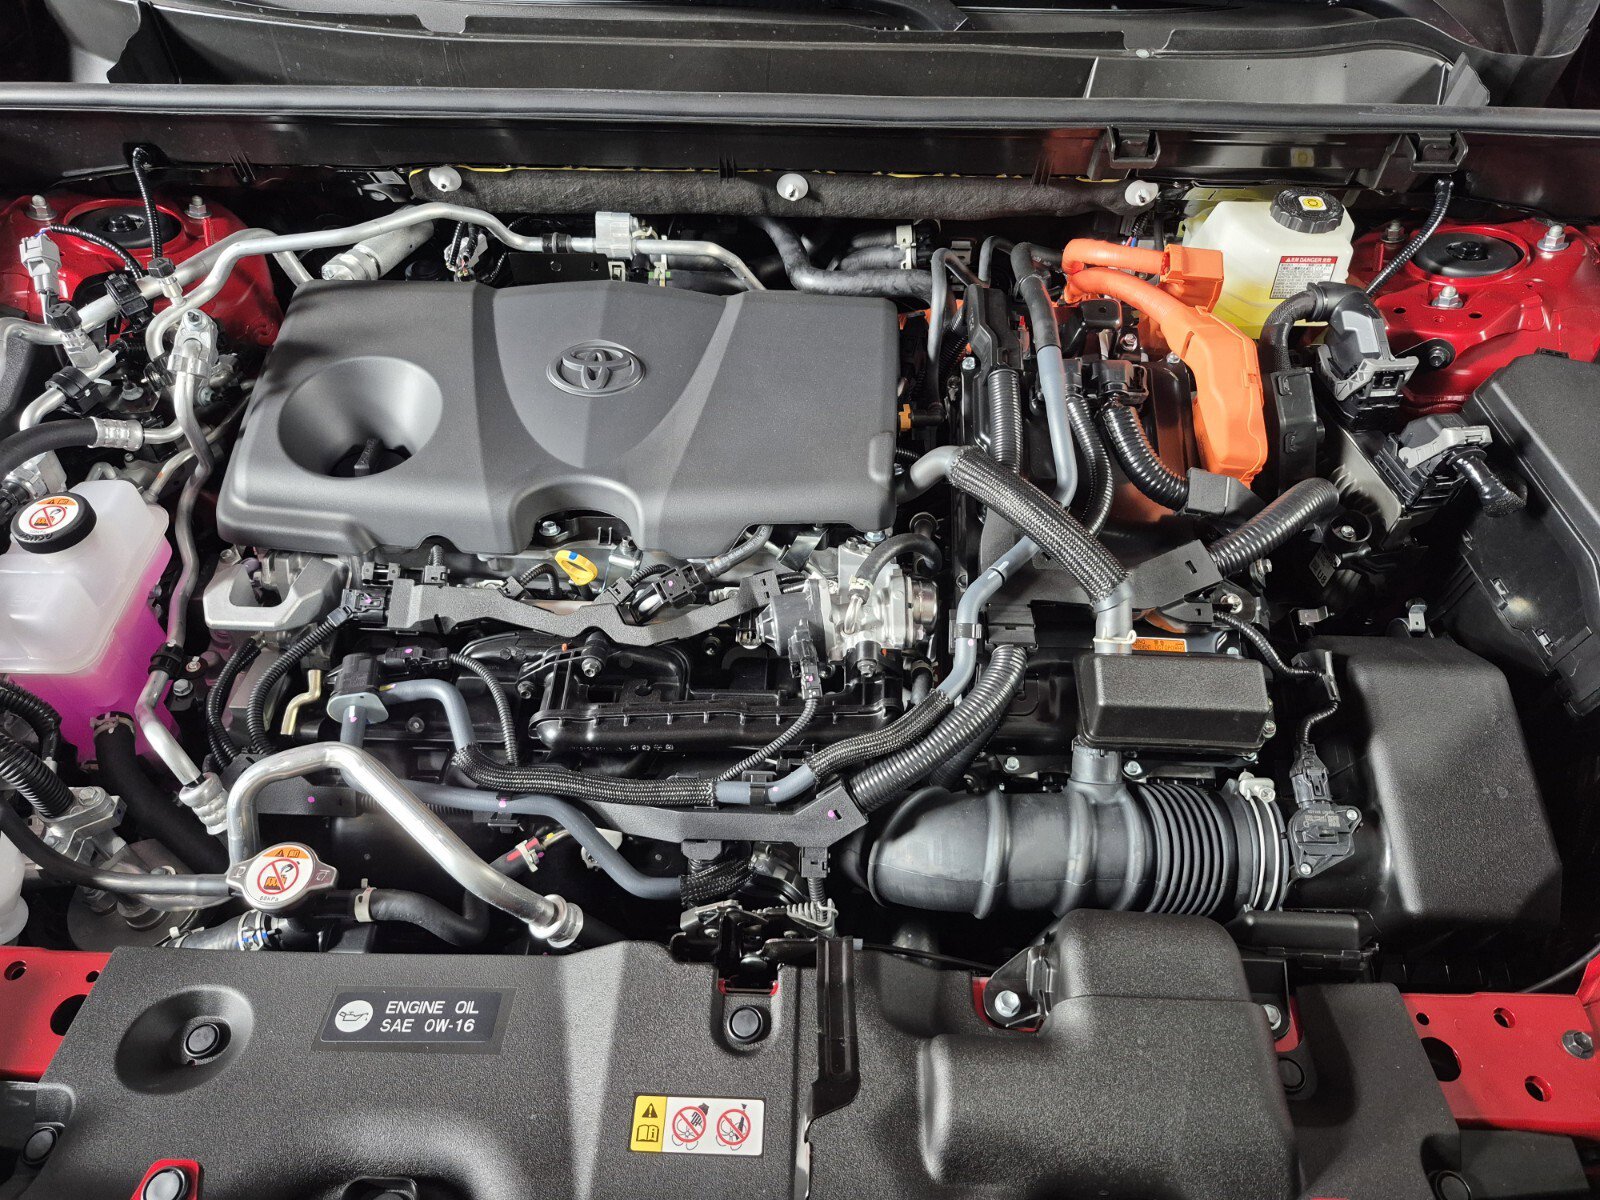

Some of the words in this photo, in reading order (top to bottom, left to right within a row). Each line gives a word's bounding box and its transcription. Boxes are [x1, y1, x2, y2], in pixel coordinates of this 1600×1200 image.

[385, 1000, 446, 1014] ENGINE
[454, 1000, 479, 1014] OIL
[379, 1018, 415, 1033] SAE
[424, 1018, 476, 1033] 0W-16
